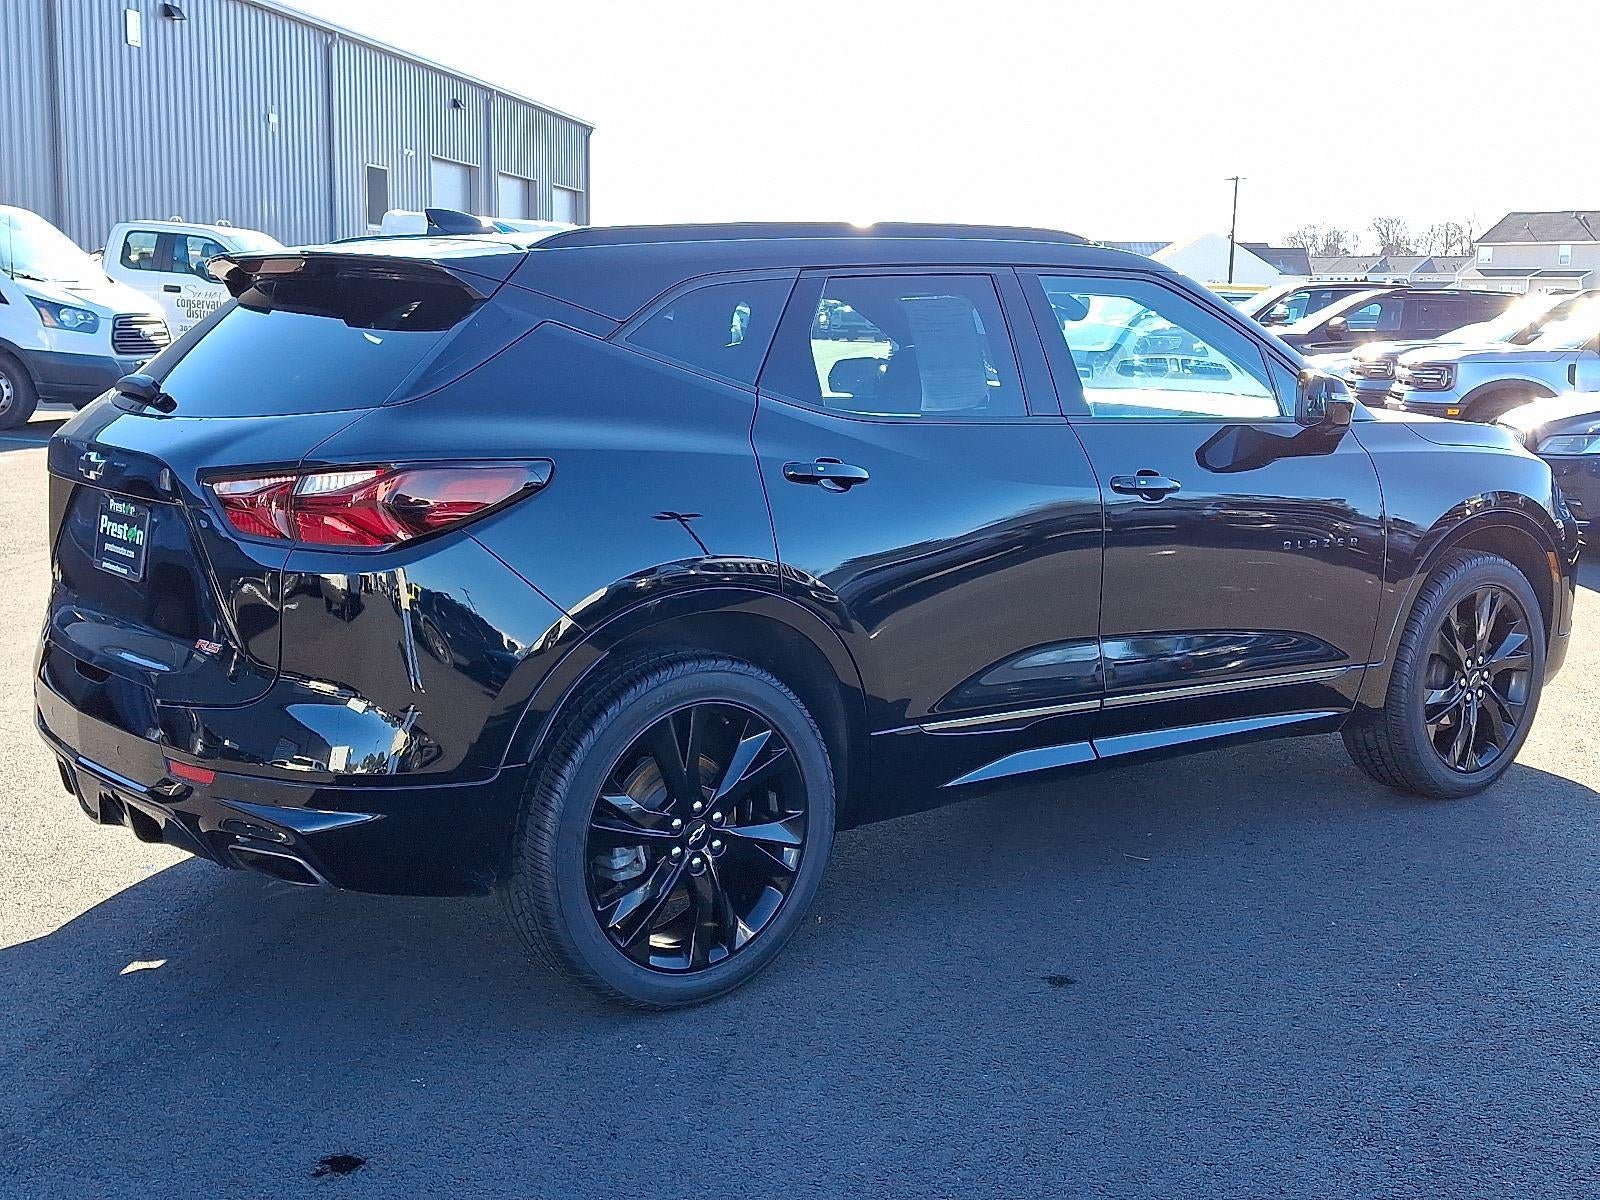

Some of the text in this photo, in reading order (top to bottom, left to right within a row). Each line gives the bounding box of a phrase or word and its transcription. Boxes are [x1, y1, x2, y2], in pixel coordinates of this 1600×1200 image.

[100, 515, 144, 546] Preston
[1283, 537, 1358, 550] BLAZER
[195, 638, 222, 653] RS
